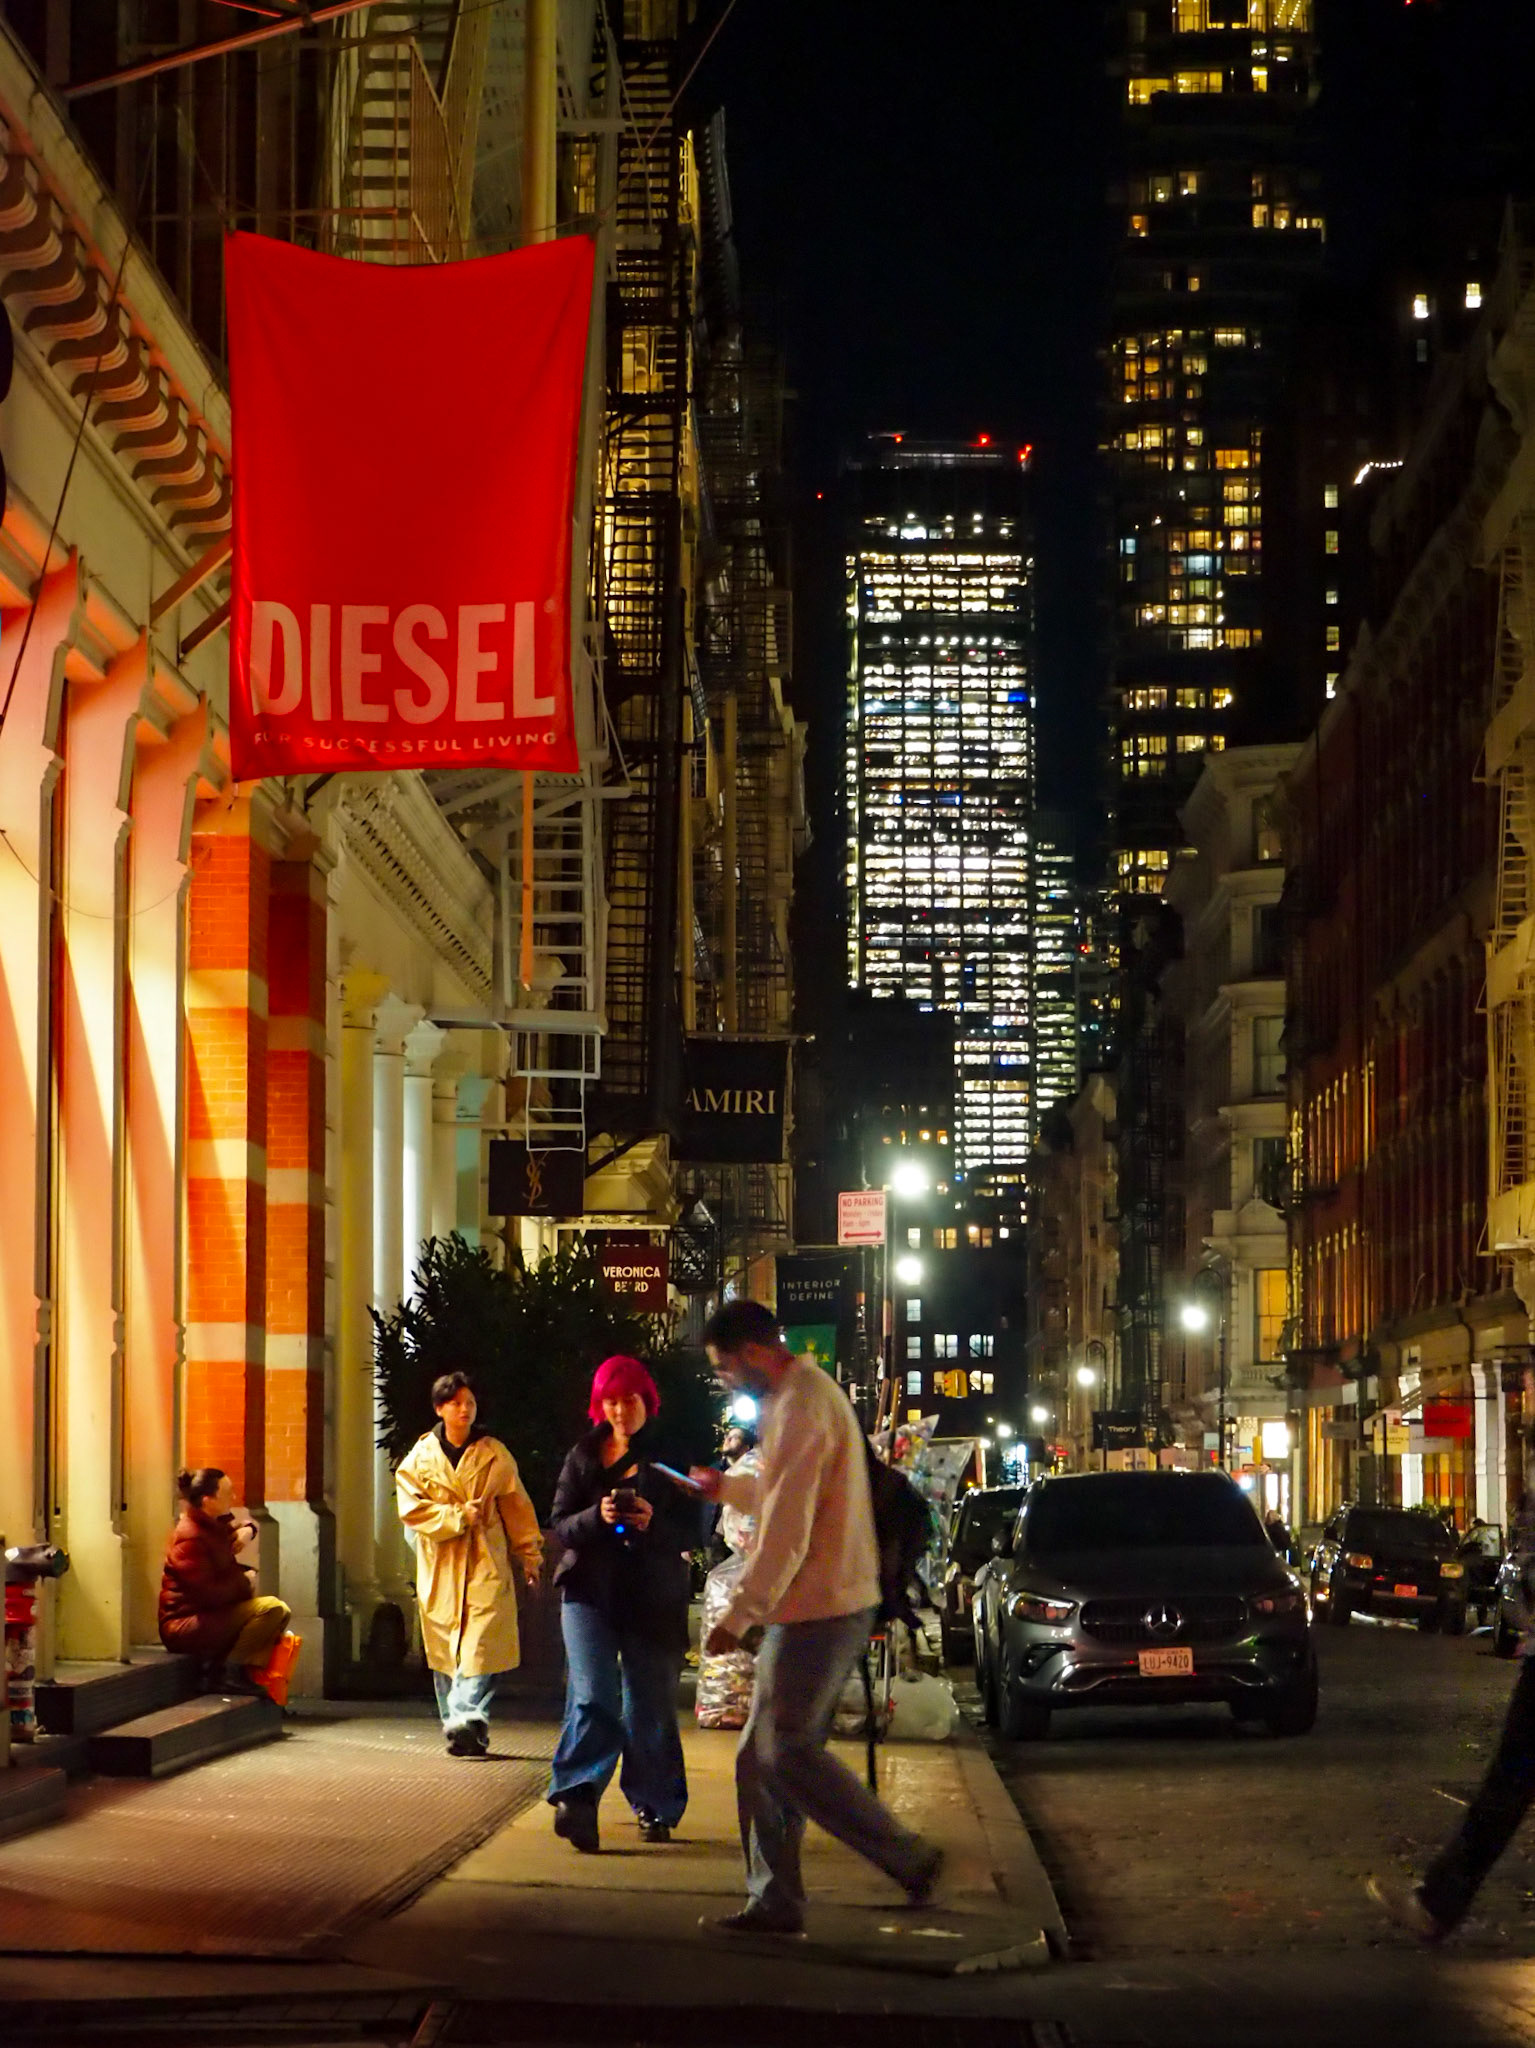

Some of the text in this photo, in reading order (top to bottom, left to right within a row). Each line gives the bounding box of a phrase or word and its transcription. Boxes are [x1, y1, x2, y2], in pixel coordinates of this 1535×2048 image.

[250, 600, 556, 725] DIESEL
[473, 731, 557, 750] LIVING
[685, 1087, 776, 1114] AMIRI
[842, 1196, 884, 1207] NO PARKING
[602, 1266, 661, 1278] VERONICA
[614, 1281, 649, 1293] BERD
[782, 1279, 841, 1290] INTERIOR
[789, 1291, 834, 1301] DEFINE
[1108, 1425, 1137, 1434] Theory
